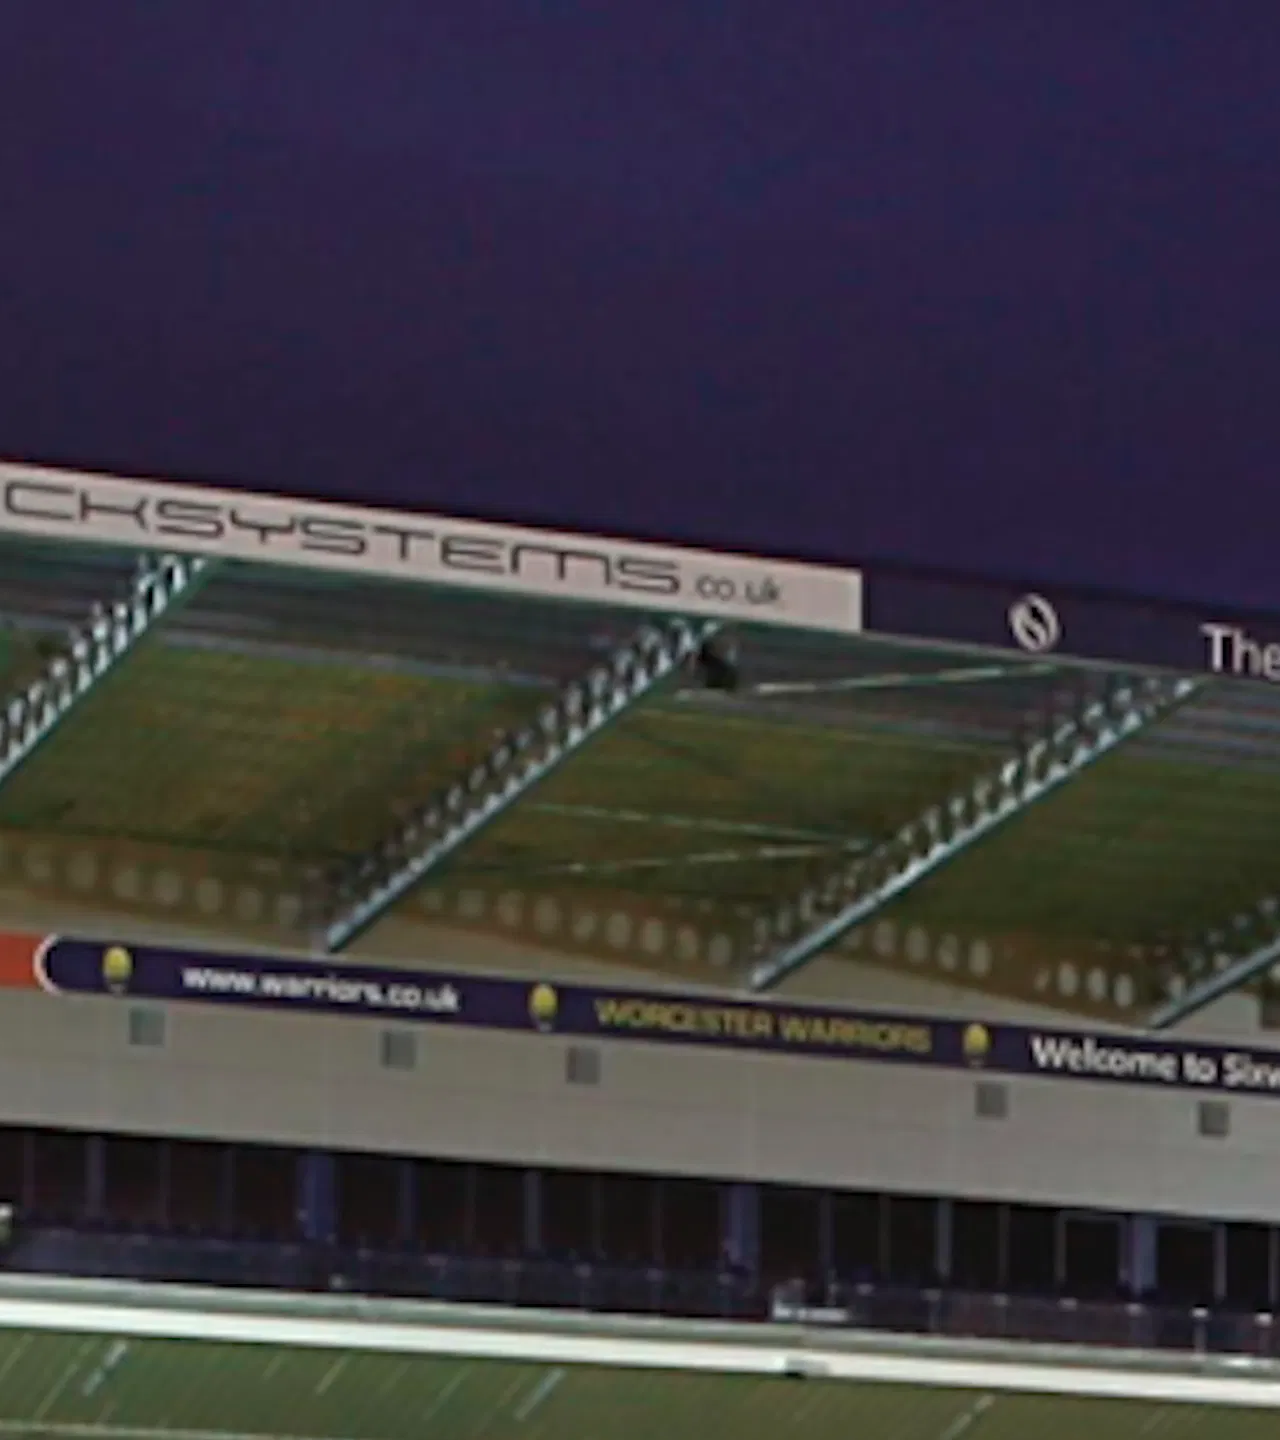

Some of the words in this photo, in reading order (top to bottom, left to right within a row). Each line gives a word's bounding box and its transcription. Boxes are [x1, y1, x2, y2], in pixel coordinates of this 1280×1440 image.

[180, 966, 460, 1014] www.warriors.co.uk
[594, 997, 771, 1038] WORCESTER
[778, 1016, 932, 1054] WARRIORS
[1030, 1035, 1175, 1081] Welcome
[1184, 1046, 1216, 1083] to
